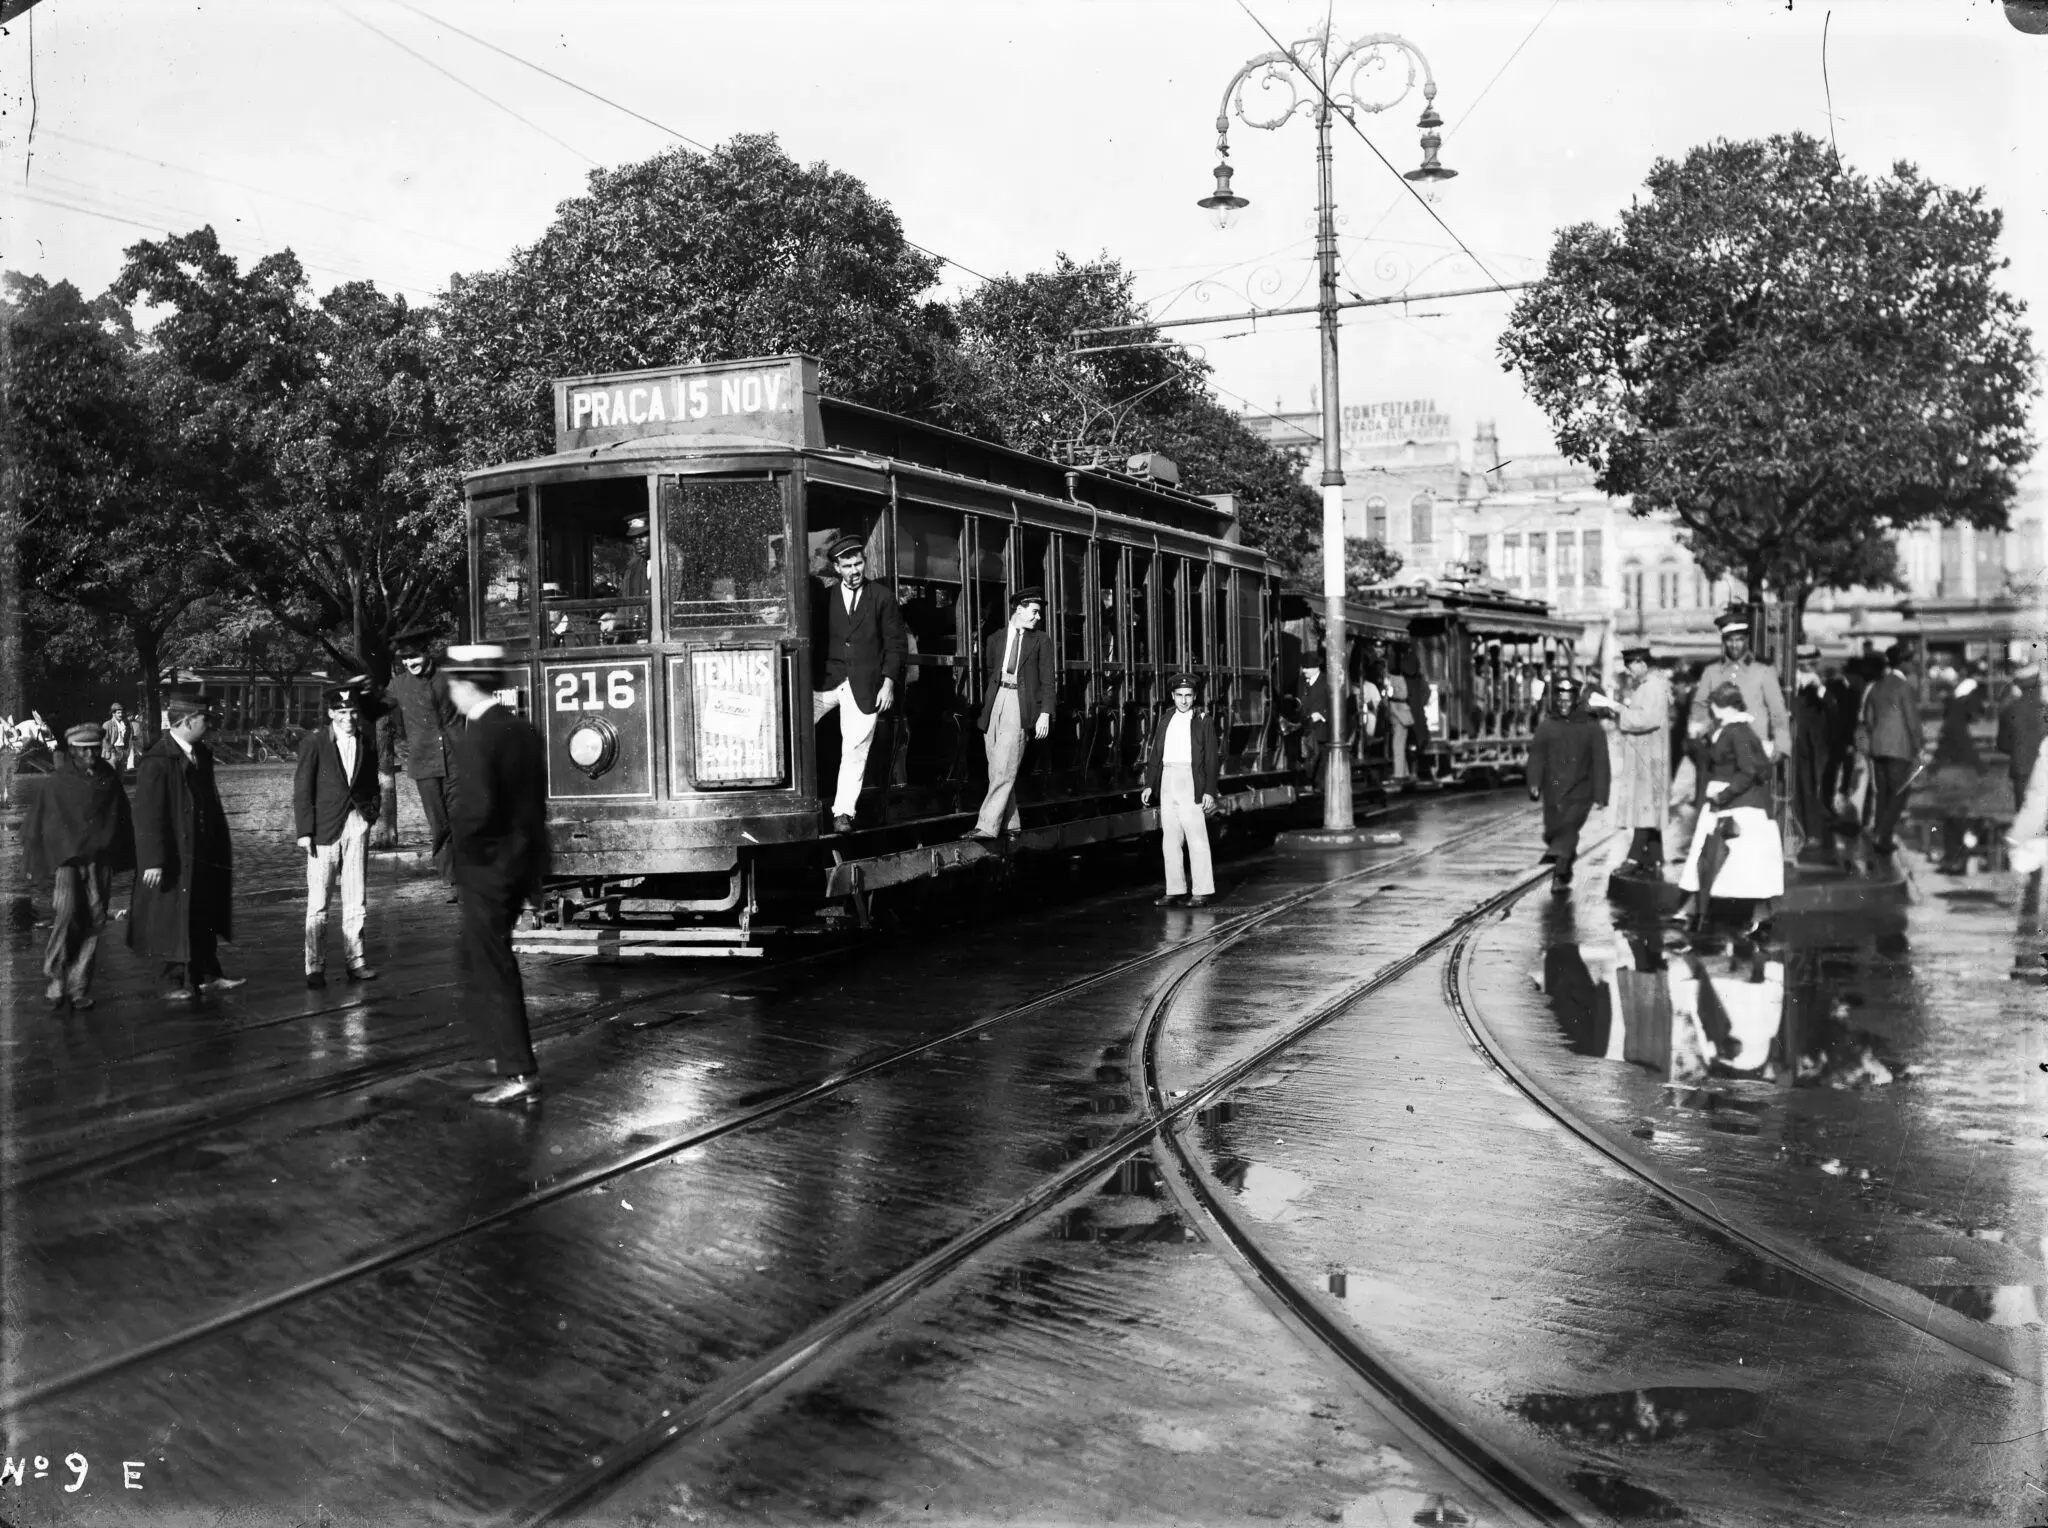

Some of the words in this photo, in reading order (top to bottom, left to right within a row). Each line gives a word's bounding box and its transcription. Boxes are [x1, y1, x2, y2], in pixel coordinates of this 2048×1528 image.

[677, 379, 709, 419] 15
[721, 373, 787, 415] NOV.
[1343, 398, 1436, 420] CONFEITARIA
[1388, 415, 1404, 429] DE
[692, 654, 771, 686] TENNIS
[555, 670, 635, 712] 216
